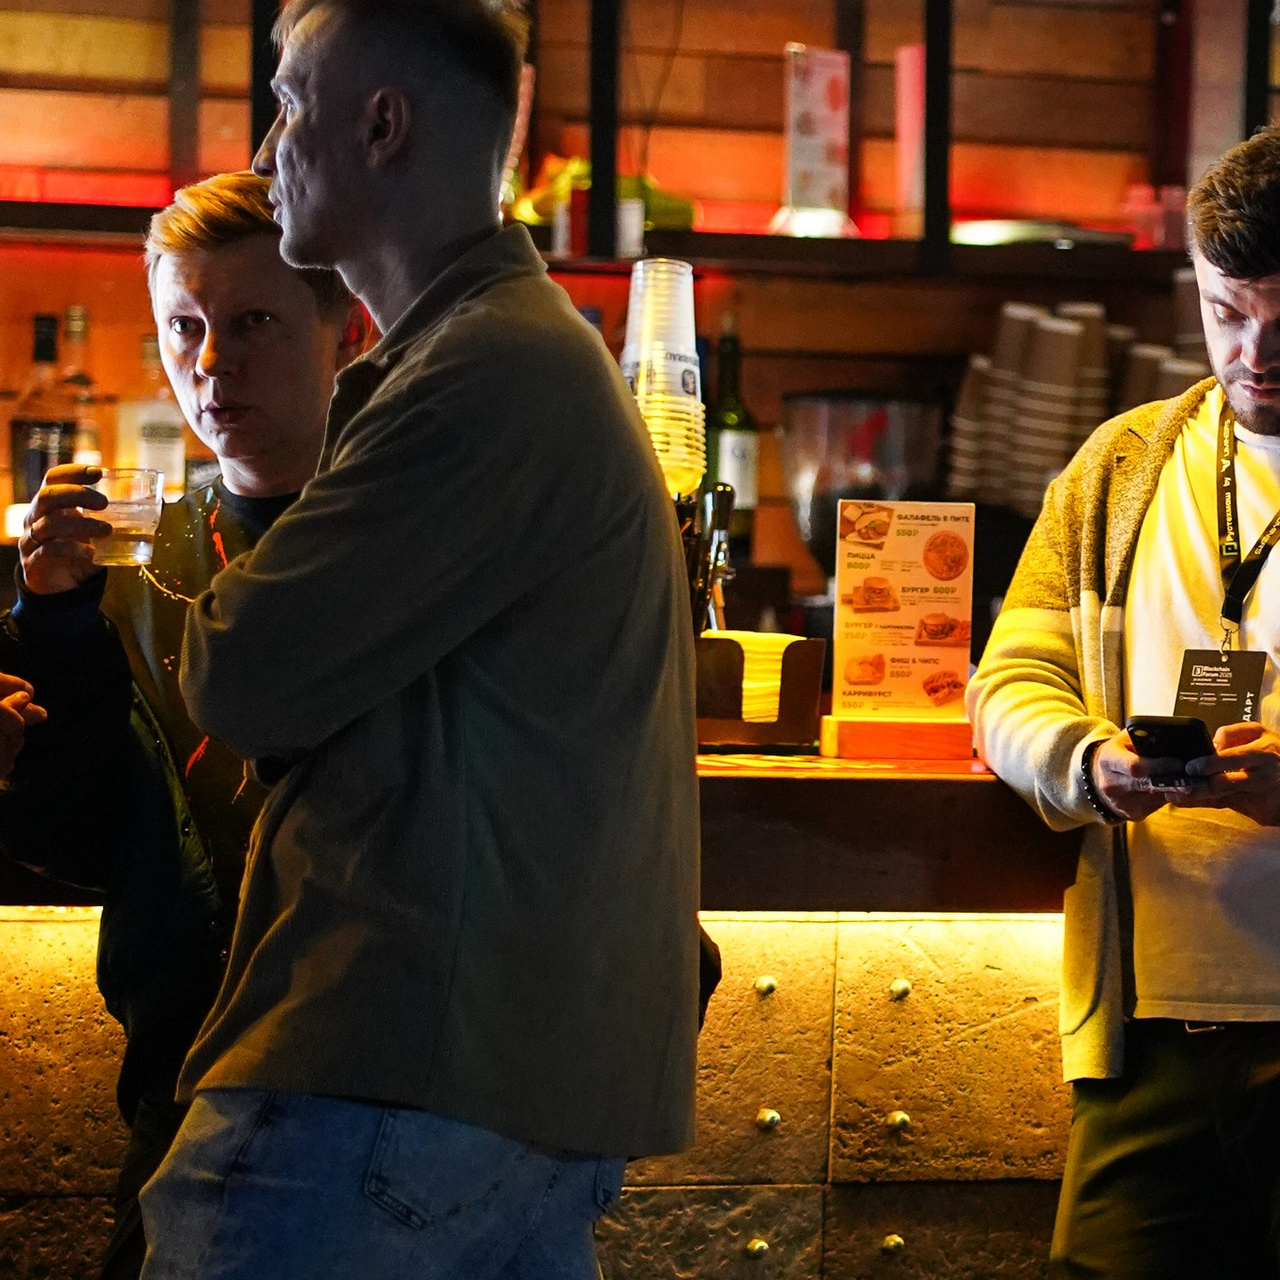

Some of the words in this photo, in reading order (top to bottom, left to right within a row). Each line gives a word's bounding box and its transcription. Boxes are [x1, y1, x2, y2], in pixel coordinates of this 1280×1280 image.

[1223, 477, 1232, 488] by
[897, 514, 941, 522] ФАЛАФЕЛЬ
[1224, 492, 1235, 542] Рустехмаш
[847, 552, 876, 560] ПИЦЦА
[901, 586, 930, 594] БУРГЕР
[842, 690, 893, 698] КАРРИВУРСТ
[1242, 691, 1255, 722] ДАРТ
